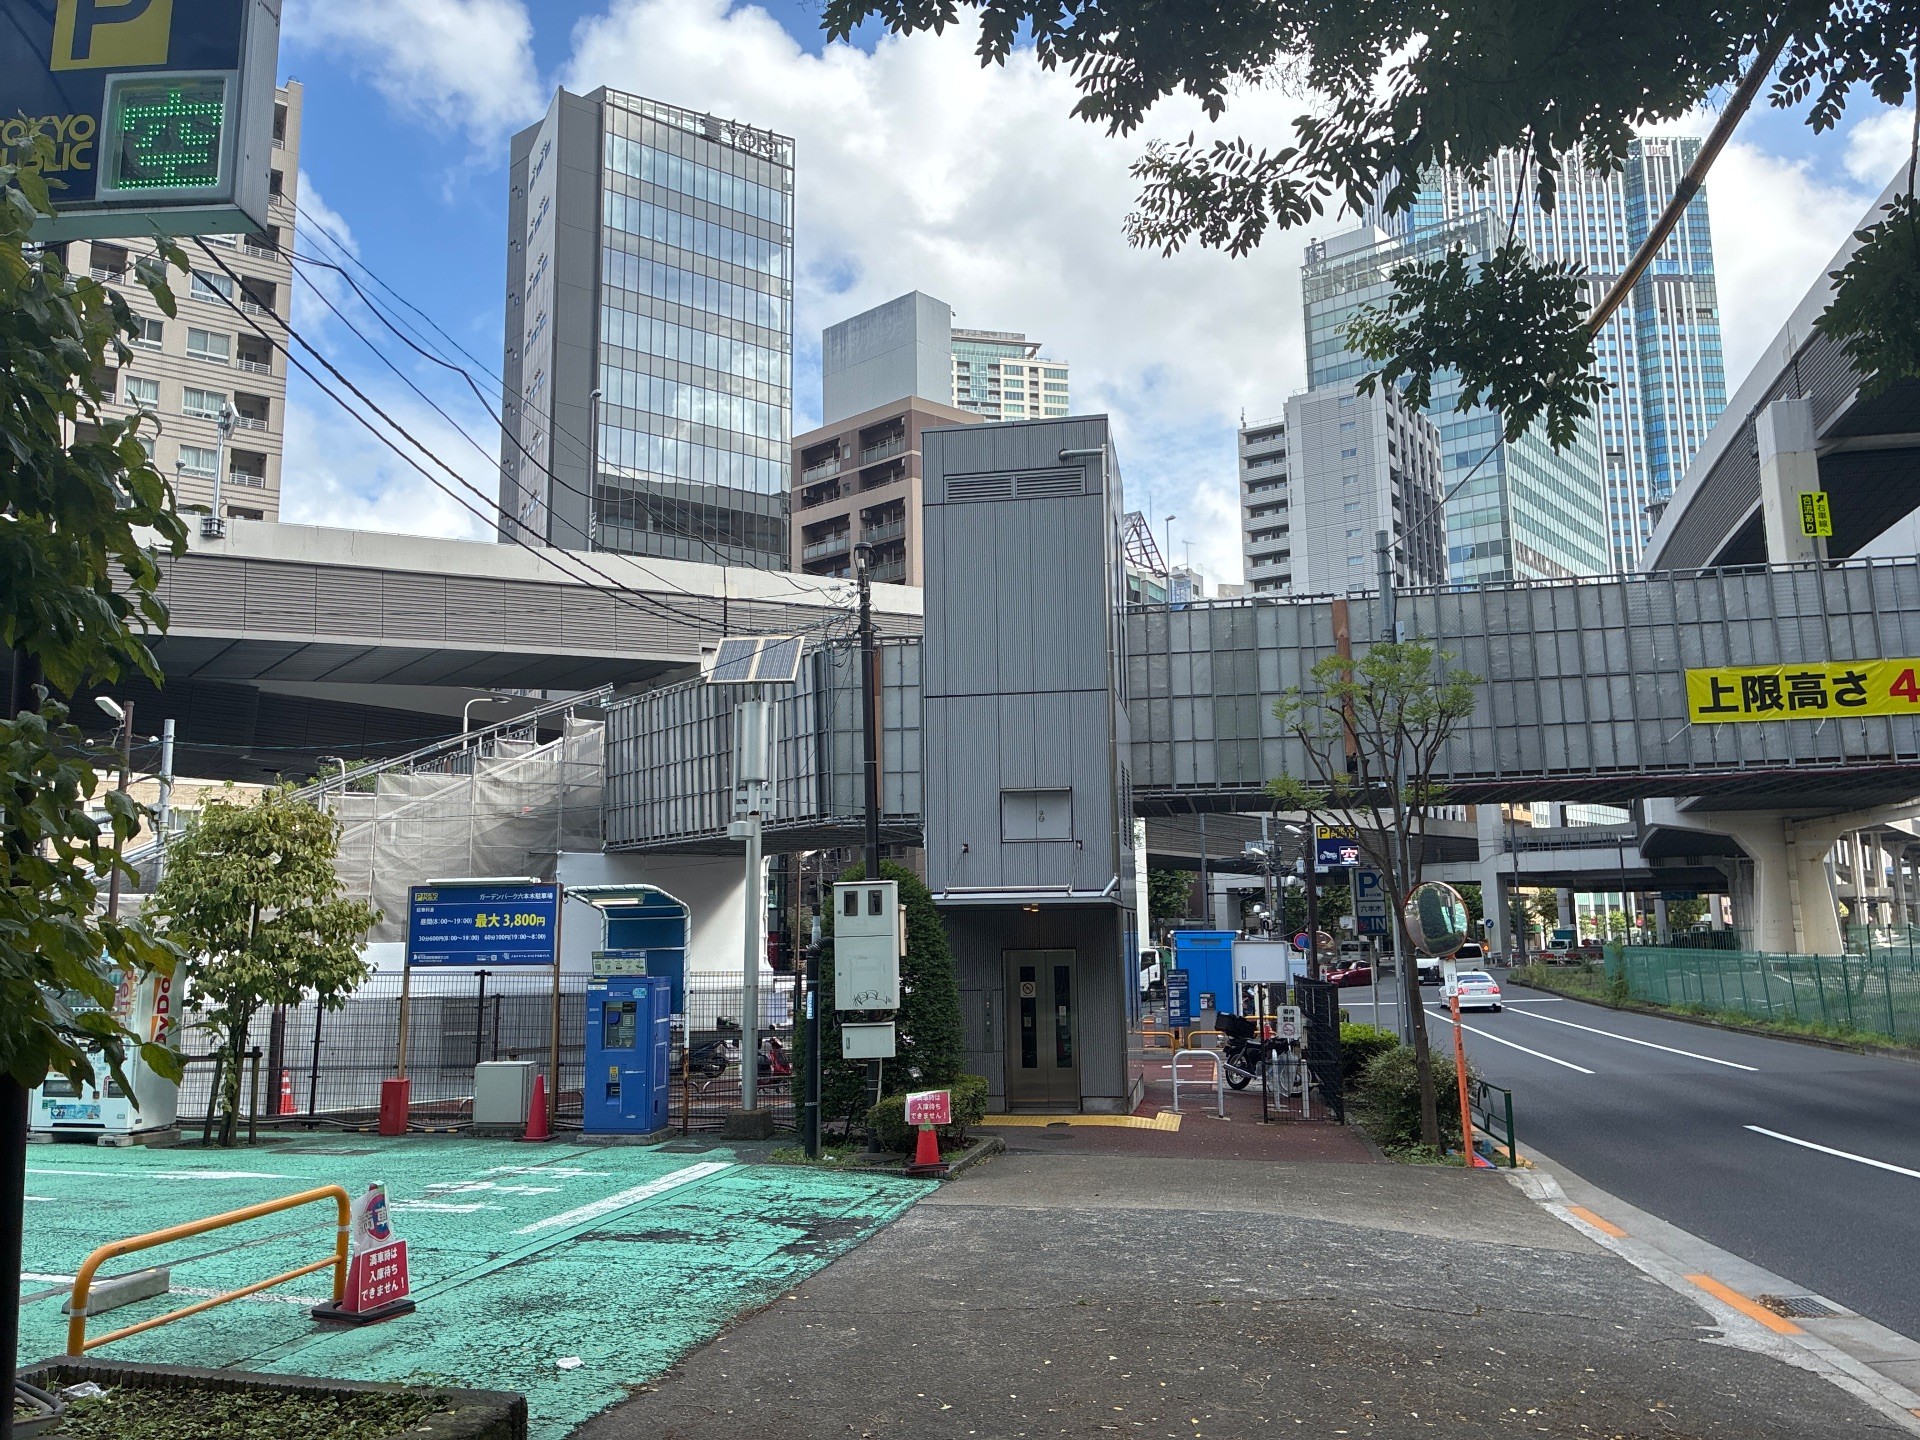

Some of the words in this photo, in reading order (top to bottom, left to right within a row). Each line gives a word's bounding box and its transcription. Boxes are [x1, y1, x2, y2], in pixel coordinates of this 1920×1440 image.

[0, 114, 96, 147] OKYO
[119, 89, 224, 191] 空
[1802, 495, 1815, 532] 合流あり
[1816, 504, 1830, 534] 右車線へ
[1698, 670, 1868, 713] 上限高さ
[1889, 668, 1920, 703] 4
[1340, 847, 1359, 865] 空
[1358, 872, 1378, 898] P
[479, 892, 553, 900] ガーデンパーク六本木駐車場
[1361, 905, 1382, 913] 六本木
[474, 913, 500, 928] 最大
[503, 913, 546, 928] 3,800円
[1371, 917, 1386, 931] IN
[917, 1103, 942, 1111] 入庫待ち
[369, 1246, 398, 1267] 満車時は
[368, 1263, 398, 1283] 入庫待ち
